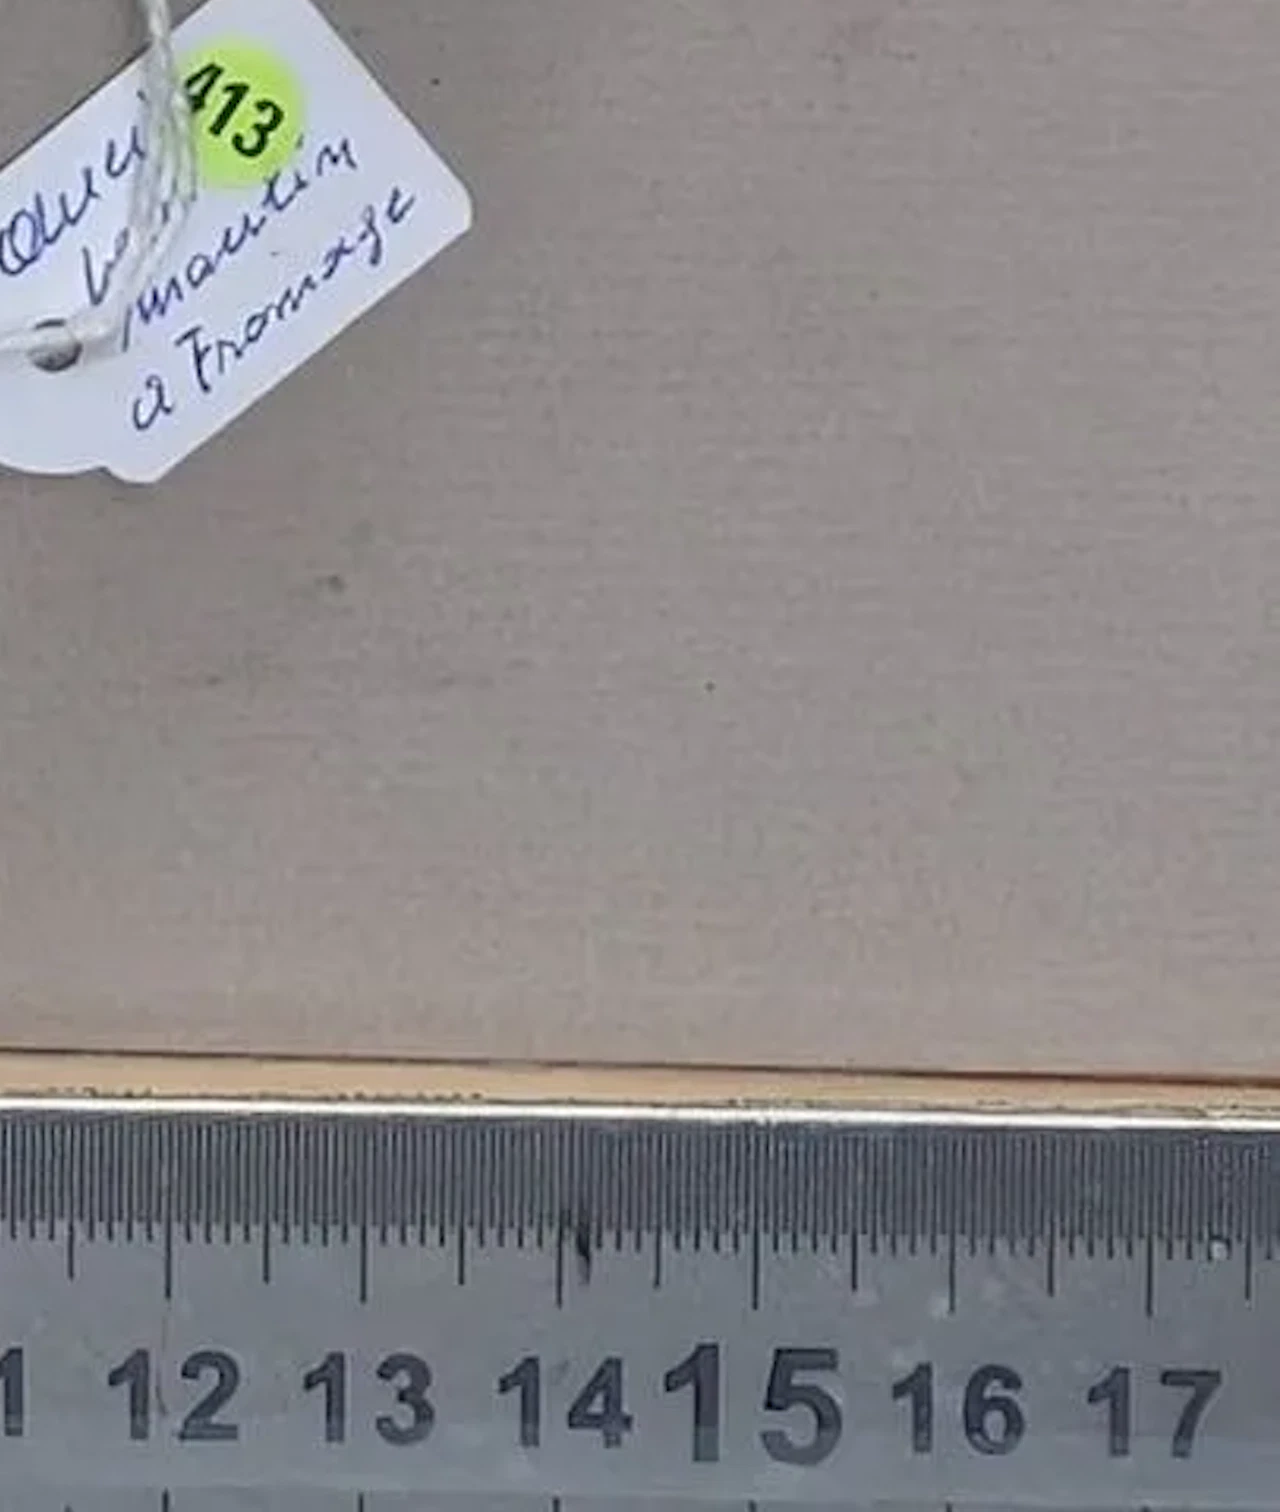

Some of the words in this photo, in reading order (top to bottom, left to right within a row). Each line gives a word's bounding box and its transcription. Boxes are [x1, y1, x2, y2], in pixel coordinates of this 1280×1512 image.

[108, 1349, 239, 1441] 12
[303, 1352, 434, 1445] 13
[498, 1357, 632, 1448] 14
[664, 1343, 841, 1464] 15
[892, 1363, 1024, 1454] 16
[1087, 1366, 1221, 1458] 17
